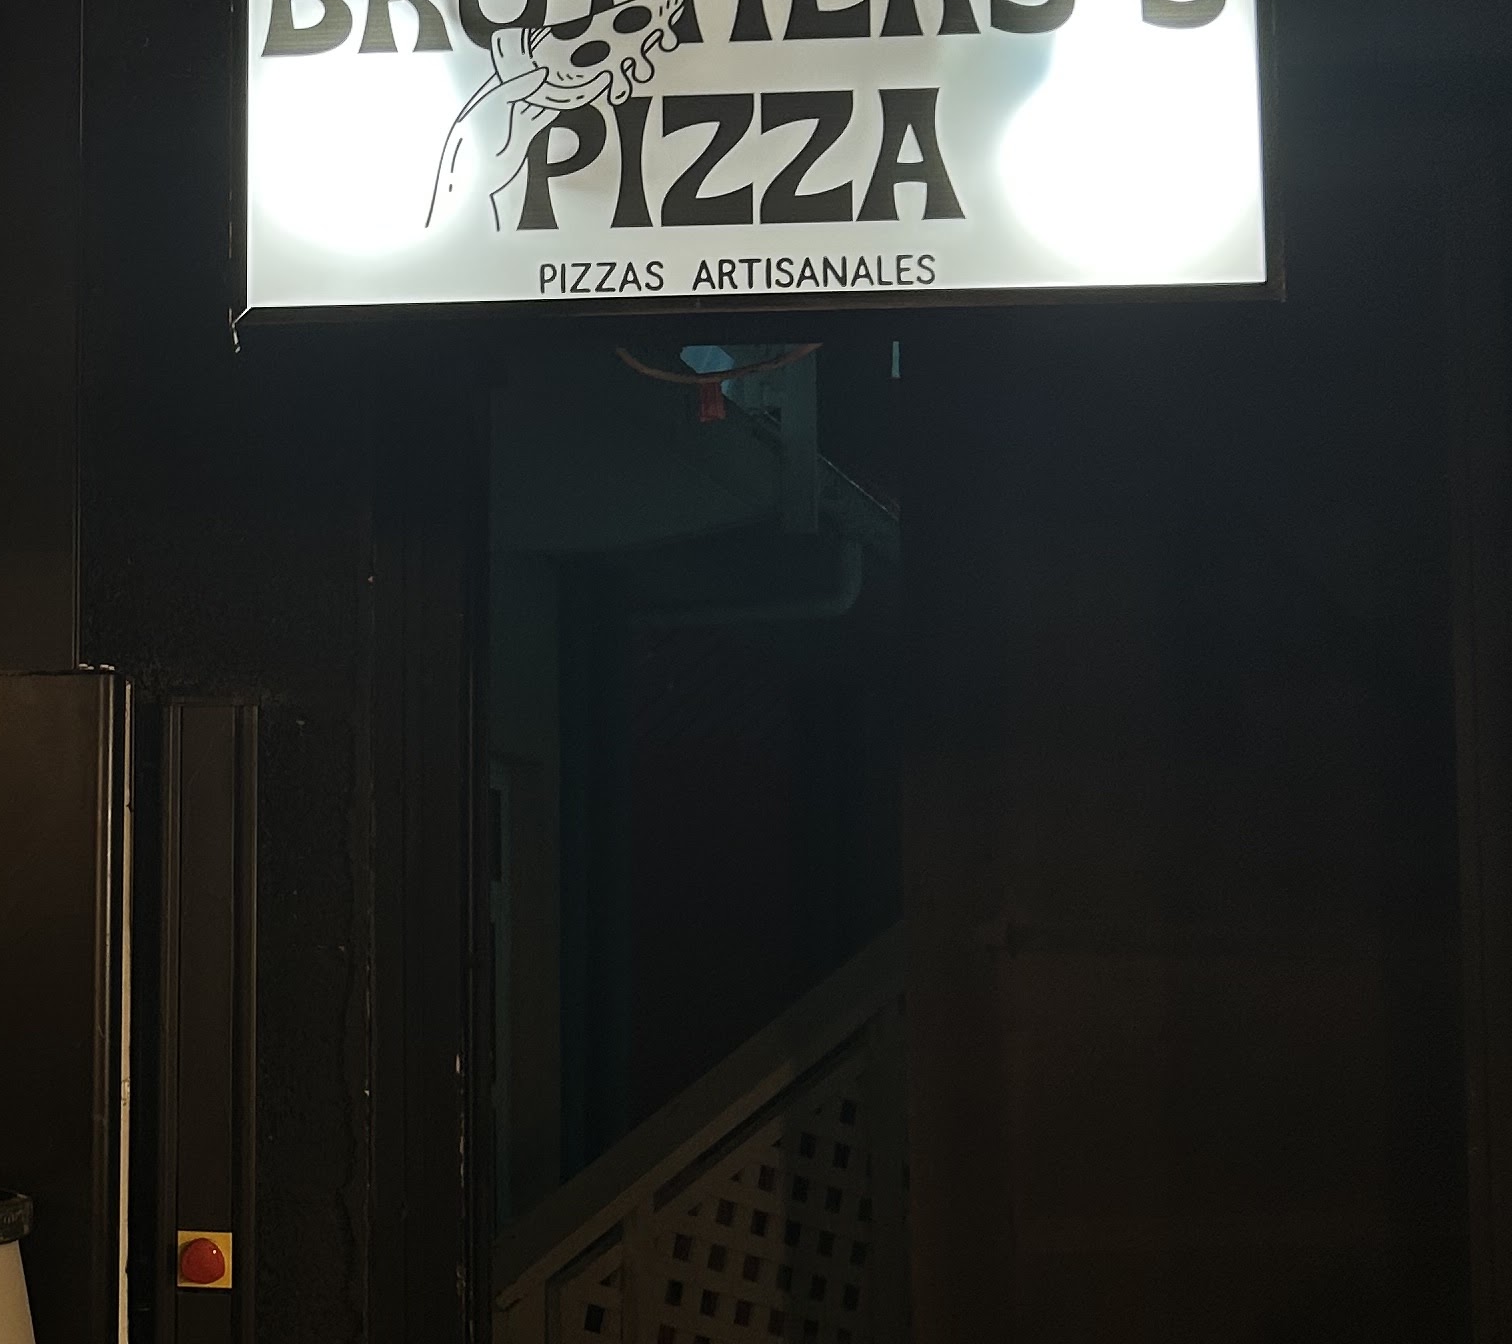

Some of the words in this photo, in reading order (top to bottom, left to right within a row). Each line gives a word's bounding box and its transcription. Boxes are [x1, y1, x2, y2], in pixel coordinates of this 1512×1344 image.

[517, 86, 966, 231] PIZZA
[539, 260, 665, 294] PIZZAS
[692, 254, 937, 292] ARTISANALES
